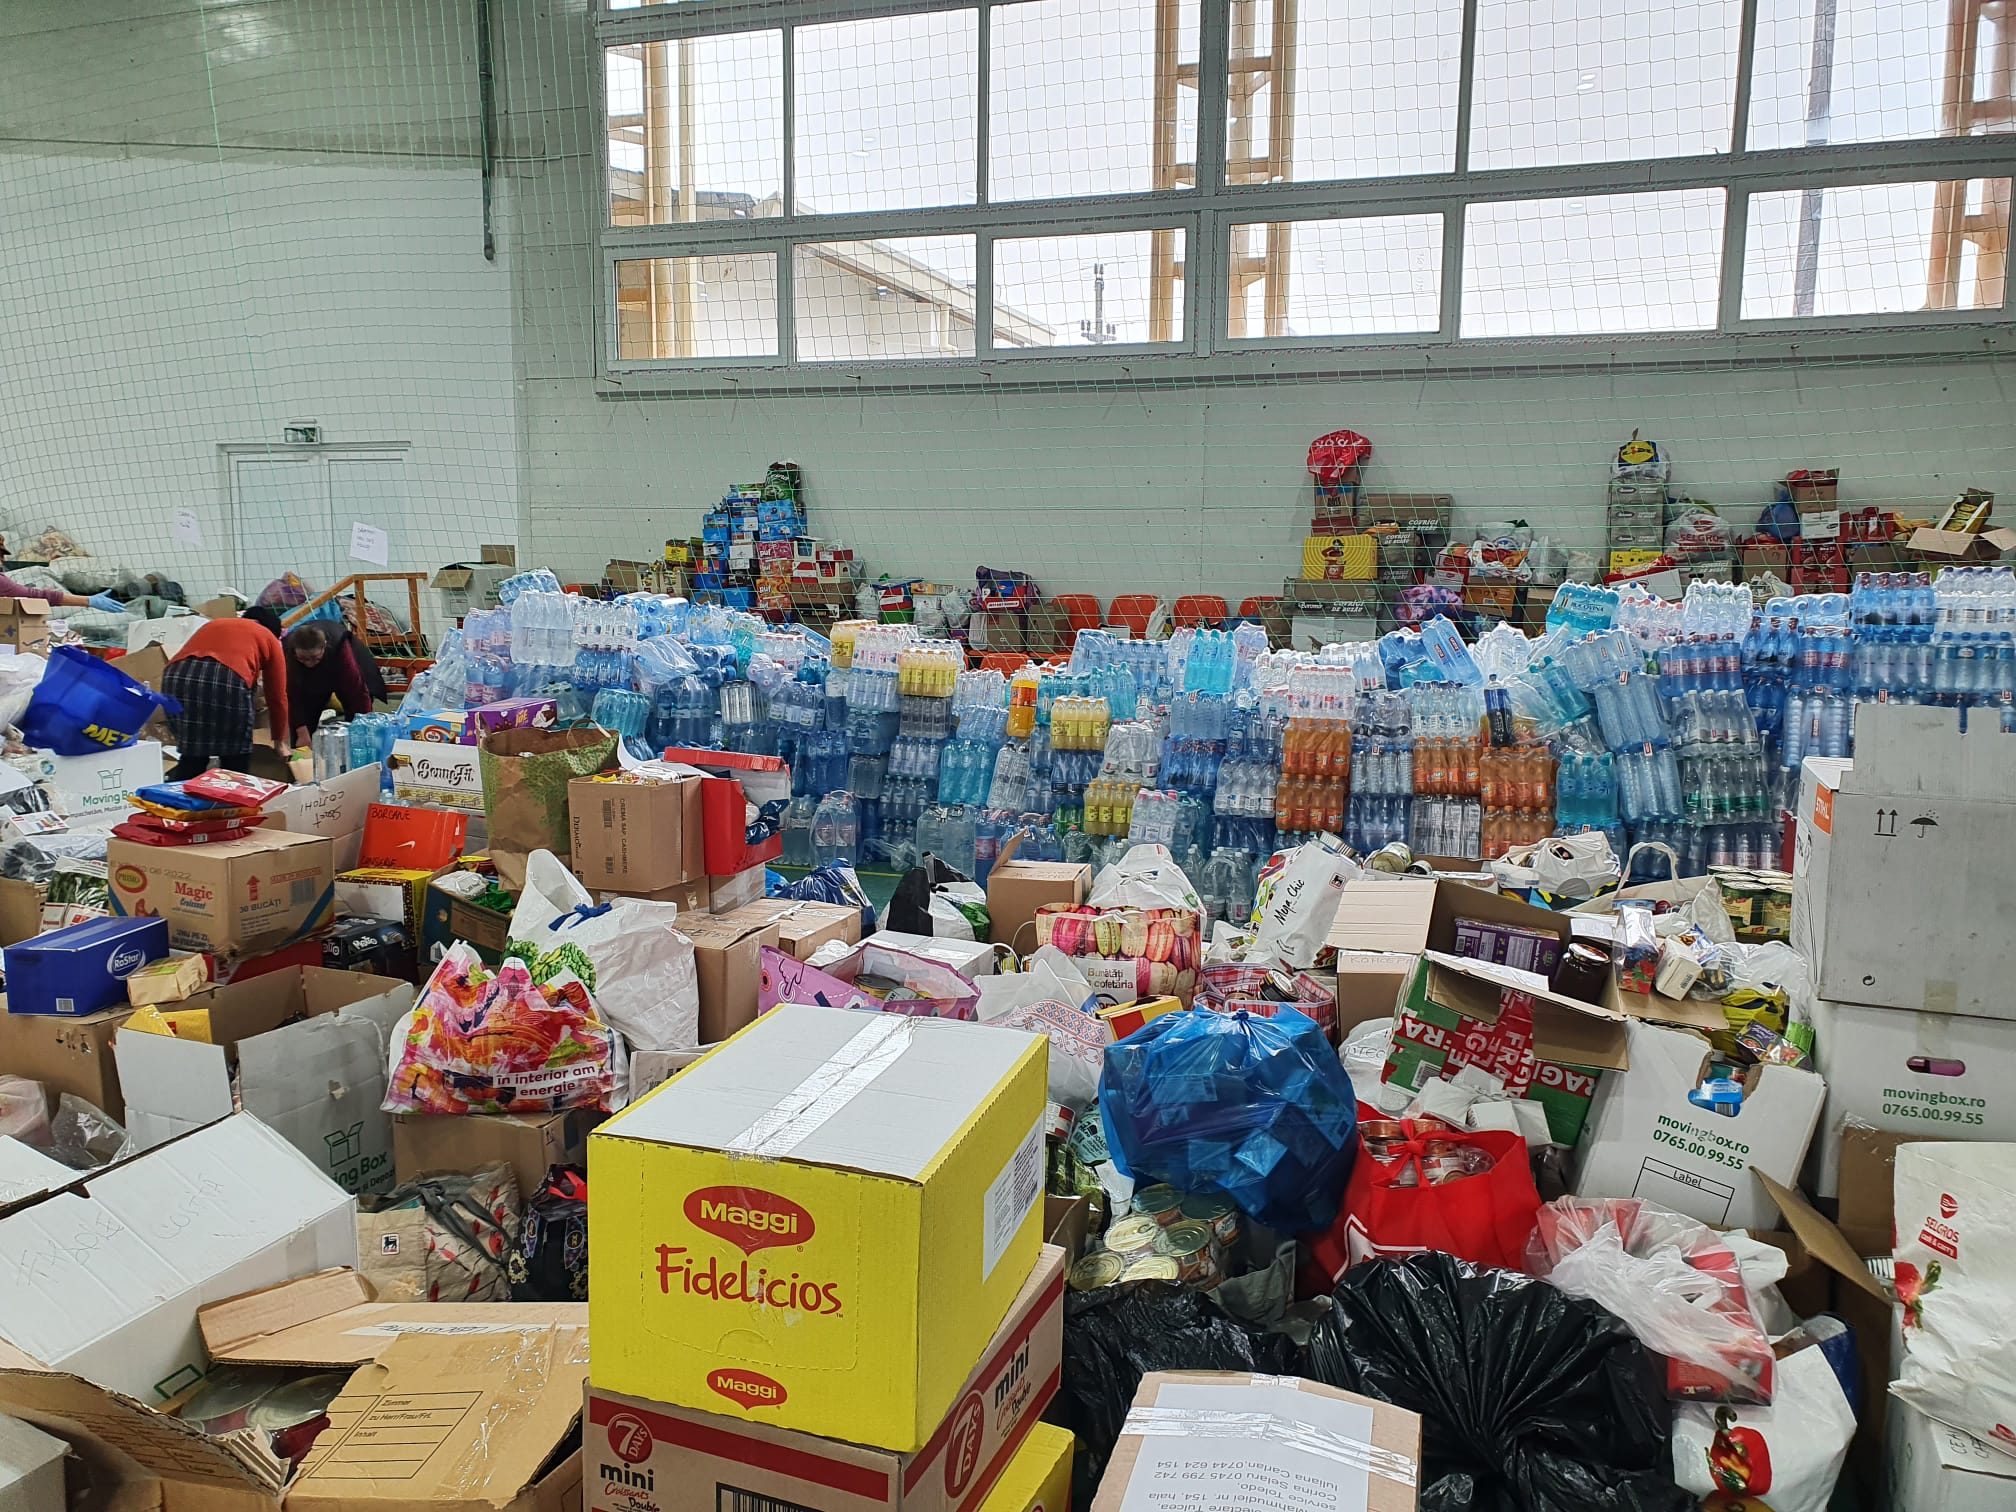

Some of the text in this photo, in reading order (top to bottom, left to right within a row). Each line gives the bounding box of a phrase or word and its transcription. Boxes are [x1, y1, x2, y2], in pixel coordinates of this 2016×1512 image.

[82, 793, 121, 807] Moving
[174, 881, 214, 902] Magic
[514, 1067, 570, 1086] interior
[572, 1064, 596, 1077] am
[519, 1081, 576, 1097] energie
[1881, 1086, 1987, 1110] movingbox.ro
[1881, 1102, 1985, 1126] 0765.00.99.55
[1657, 1111, 1751, 1156] movingbox.ro
[1652, 1128, 1745, 1172] 0765.00.99.55
[360, 1151, 387, 1176] Box
[1672, 1168, 1703, 1190] Label
[699, 1197, 799, 1235] Maggi
[1924, 1215, 1961, 1244] SELGROS
[653, 1242, 843, 1317] Fidelicios
[994, 1333, 1031, 1410] mini
[716, 1374, 778, 1400] Maggi
[615, 1420, 639, 1456] 7
[628, 1427, 649, 1458] DAYS
[952, 1403, 976, 1489] 7
[962, 1402, 981, 1474] DAYS
[600, 1462, 654, 1492] mini
[1157, 1461, 1179, 1469] 154
[1184, 1461, 1208, 1469] 624
[1148, 1492, 1176, 1501] hala
[1153, 1471, 1338, 1502] Corina Selaru 0745 799 742
[628, 1497, 661, 1512] Double
[1288, 1494, 1337, 1511] service
